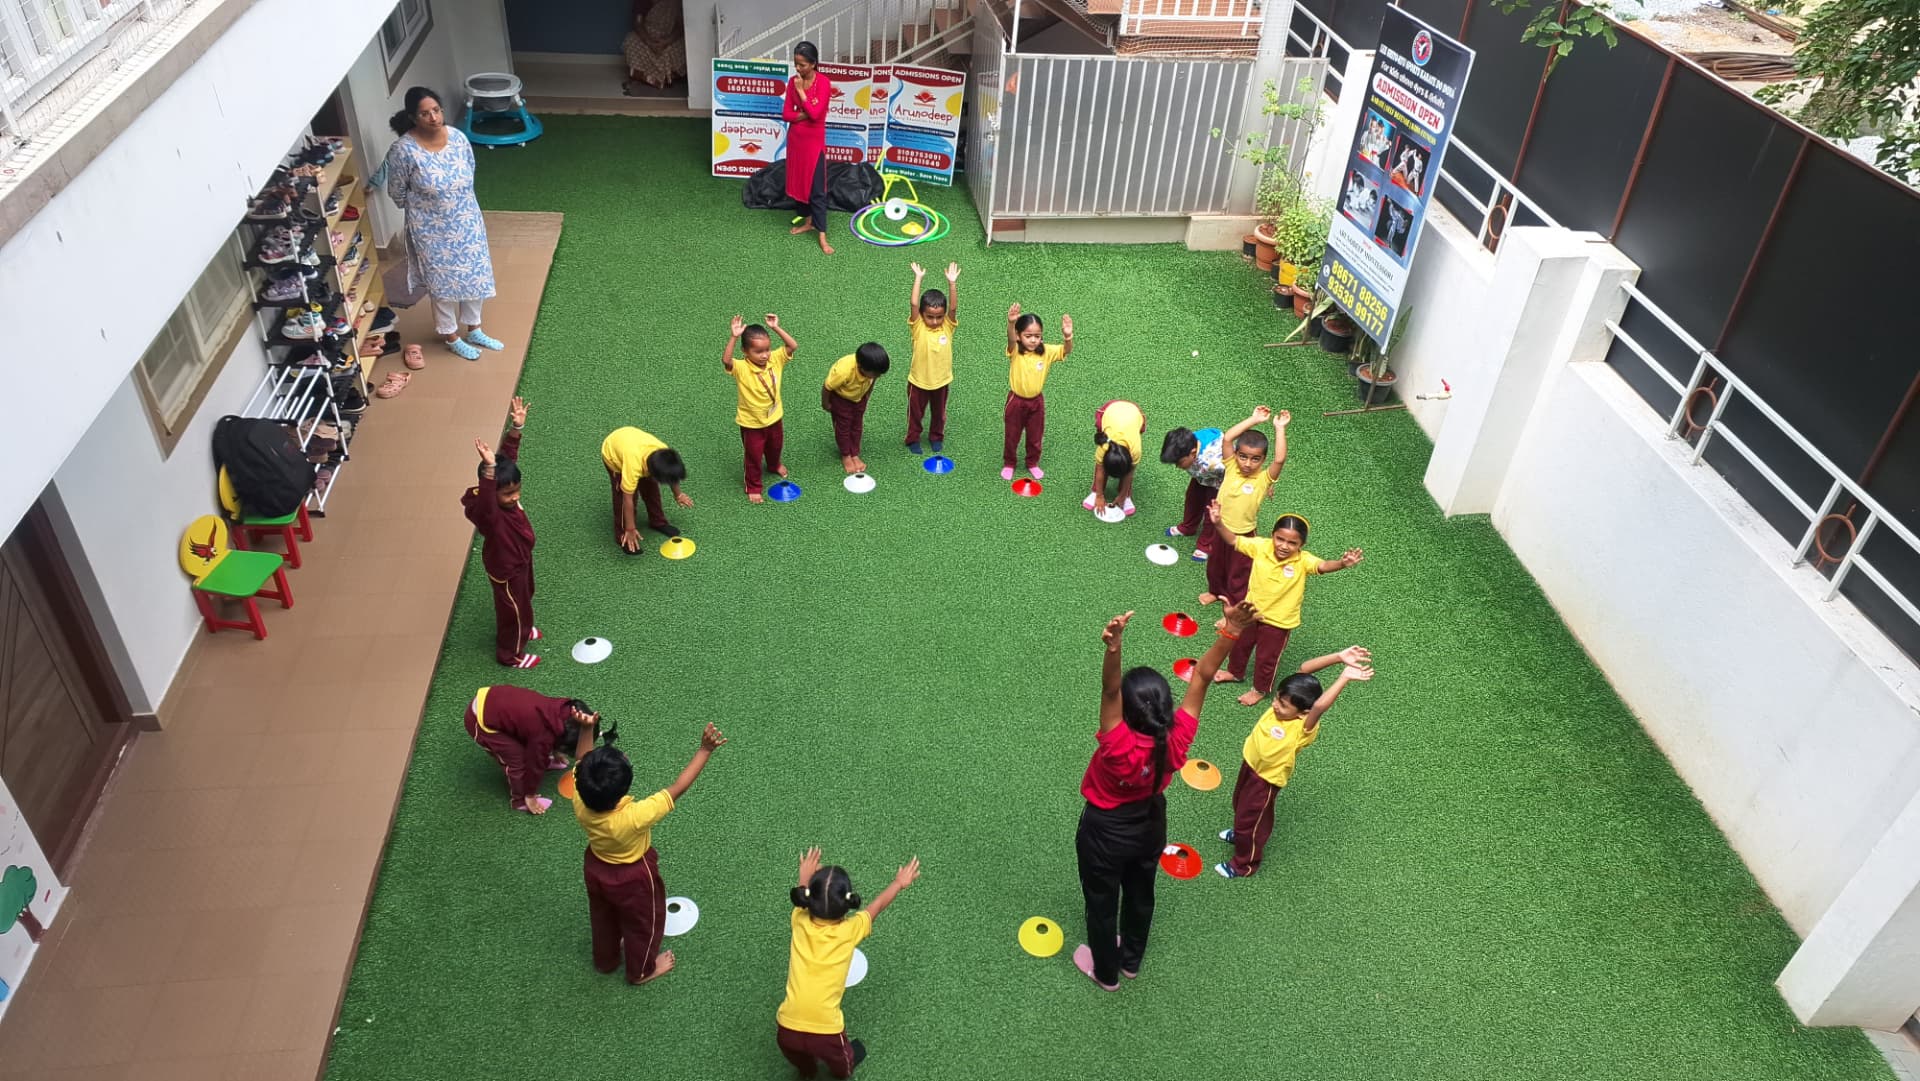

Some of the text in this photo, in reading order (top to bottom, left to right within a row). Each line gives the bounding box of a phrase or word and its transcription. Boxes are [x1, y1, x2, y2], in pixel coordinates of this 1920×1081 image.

[818, 66, 847, 75] ISSIONS
[848, 69, 870, 77] OPEN
[895, 69, 940, 80] ADMISSIONS
[941, 74, 962, 83] OPEN
[830, 103, 862, 119] odeep
[1376, 78, 1440, 129] ADMISSION OPEN
[894, 103, 953, 126] Arunodeep
[720, 121, 780, 140] Arunodeep
[716, 165, 737, 173] OPEN
[1331, 260, 1359, 294] 88671
[1359, 286, 1388, 321] 88256
[1327, 275, 1384, 337] 93538 99177
